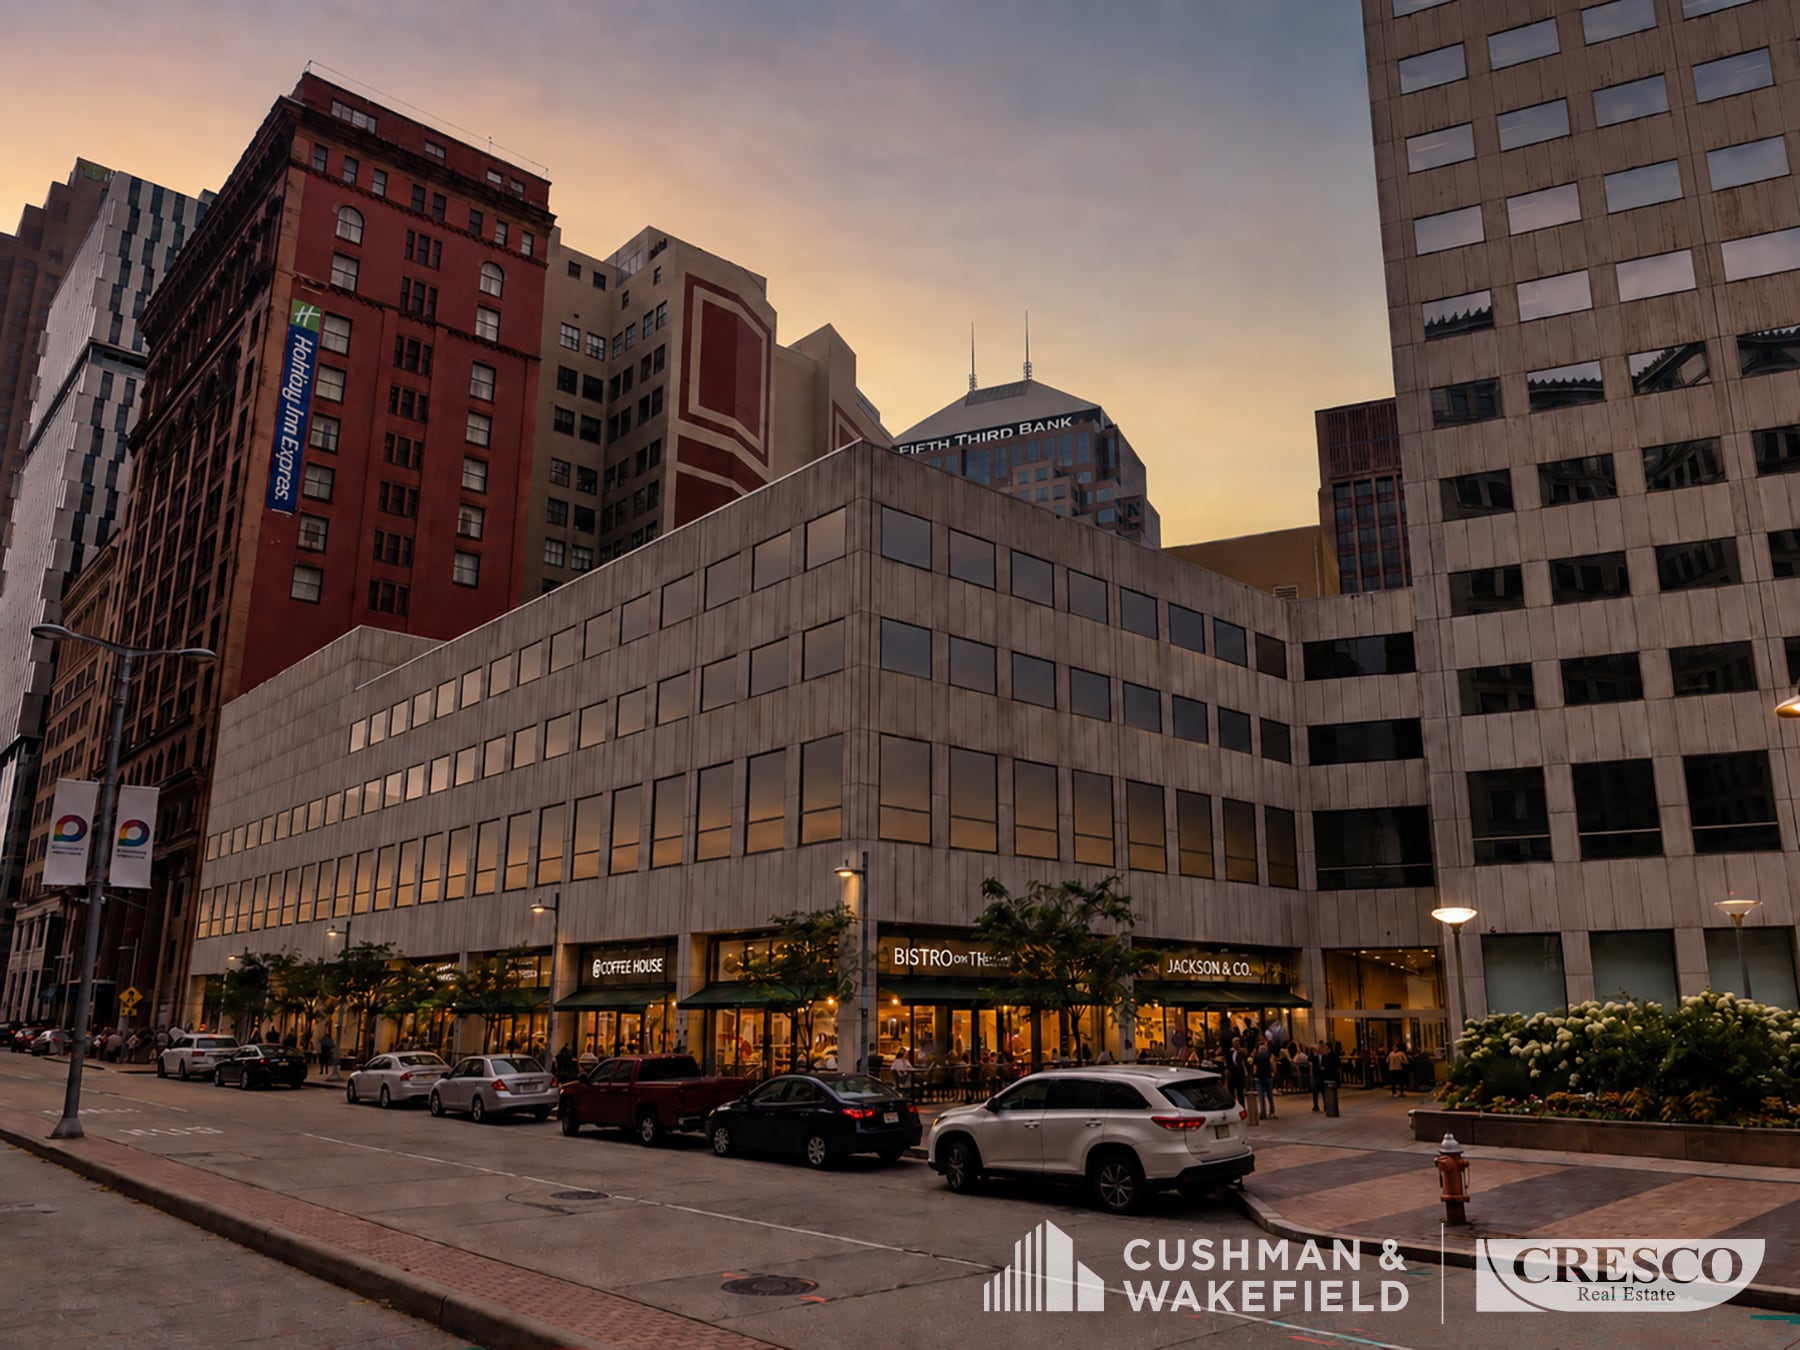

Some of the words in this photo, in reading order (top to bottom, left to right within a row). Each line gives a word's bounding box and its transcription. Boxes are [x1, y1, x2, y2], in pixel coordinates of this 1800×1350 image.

[282, 402, 305, 435] Inn
[899, 439, 950, 455] FIFTH
[954, 427, 1013, 446] THIRD
[1018, 416, 1073, 436] BANK
[601, 960, 632, 975] COFFEE
[633, 958, 663, 974] HOUSE
[894, 947, 953, 967] BISTRO
[1167, 959, 1220, 975] JACKSON
[1221, 961, 1231, 976] &
[1233, 961, 1252, 976] CO.
